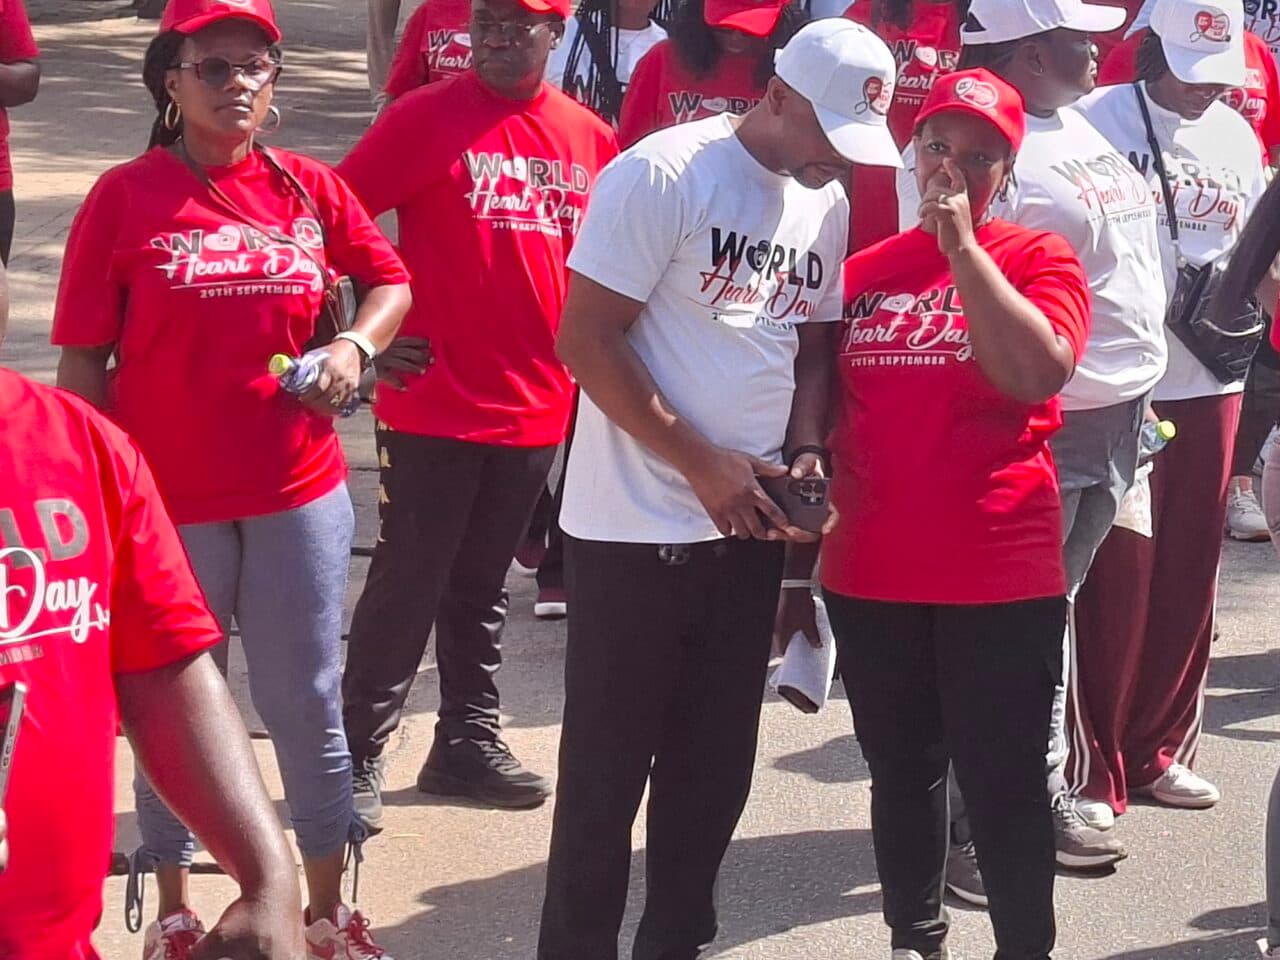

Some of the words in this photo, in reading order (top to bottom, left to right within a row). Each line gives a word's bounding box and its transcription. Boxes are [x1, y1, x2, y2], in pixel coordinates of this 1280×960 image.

[462, 149, 590, 195] WORLD
[464, 177, 533, 217] Heart
[1189, 177, 1238, 232] Day
[153, 245, 256, 286] Heart
[262, 243, 325, 293] Day
[699, 255, 766, 306] Heart
[711, 226, 824, 290] WORLD
[842, 284, 964, 320] WORL
[879, 355, 946, 367] SEPTEMBER
